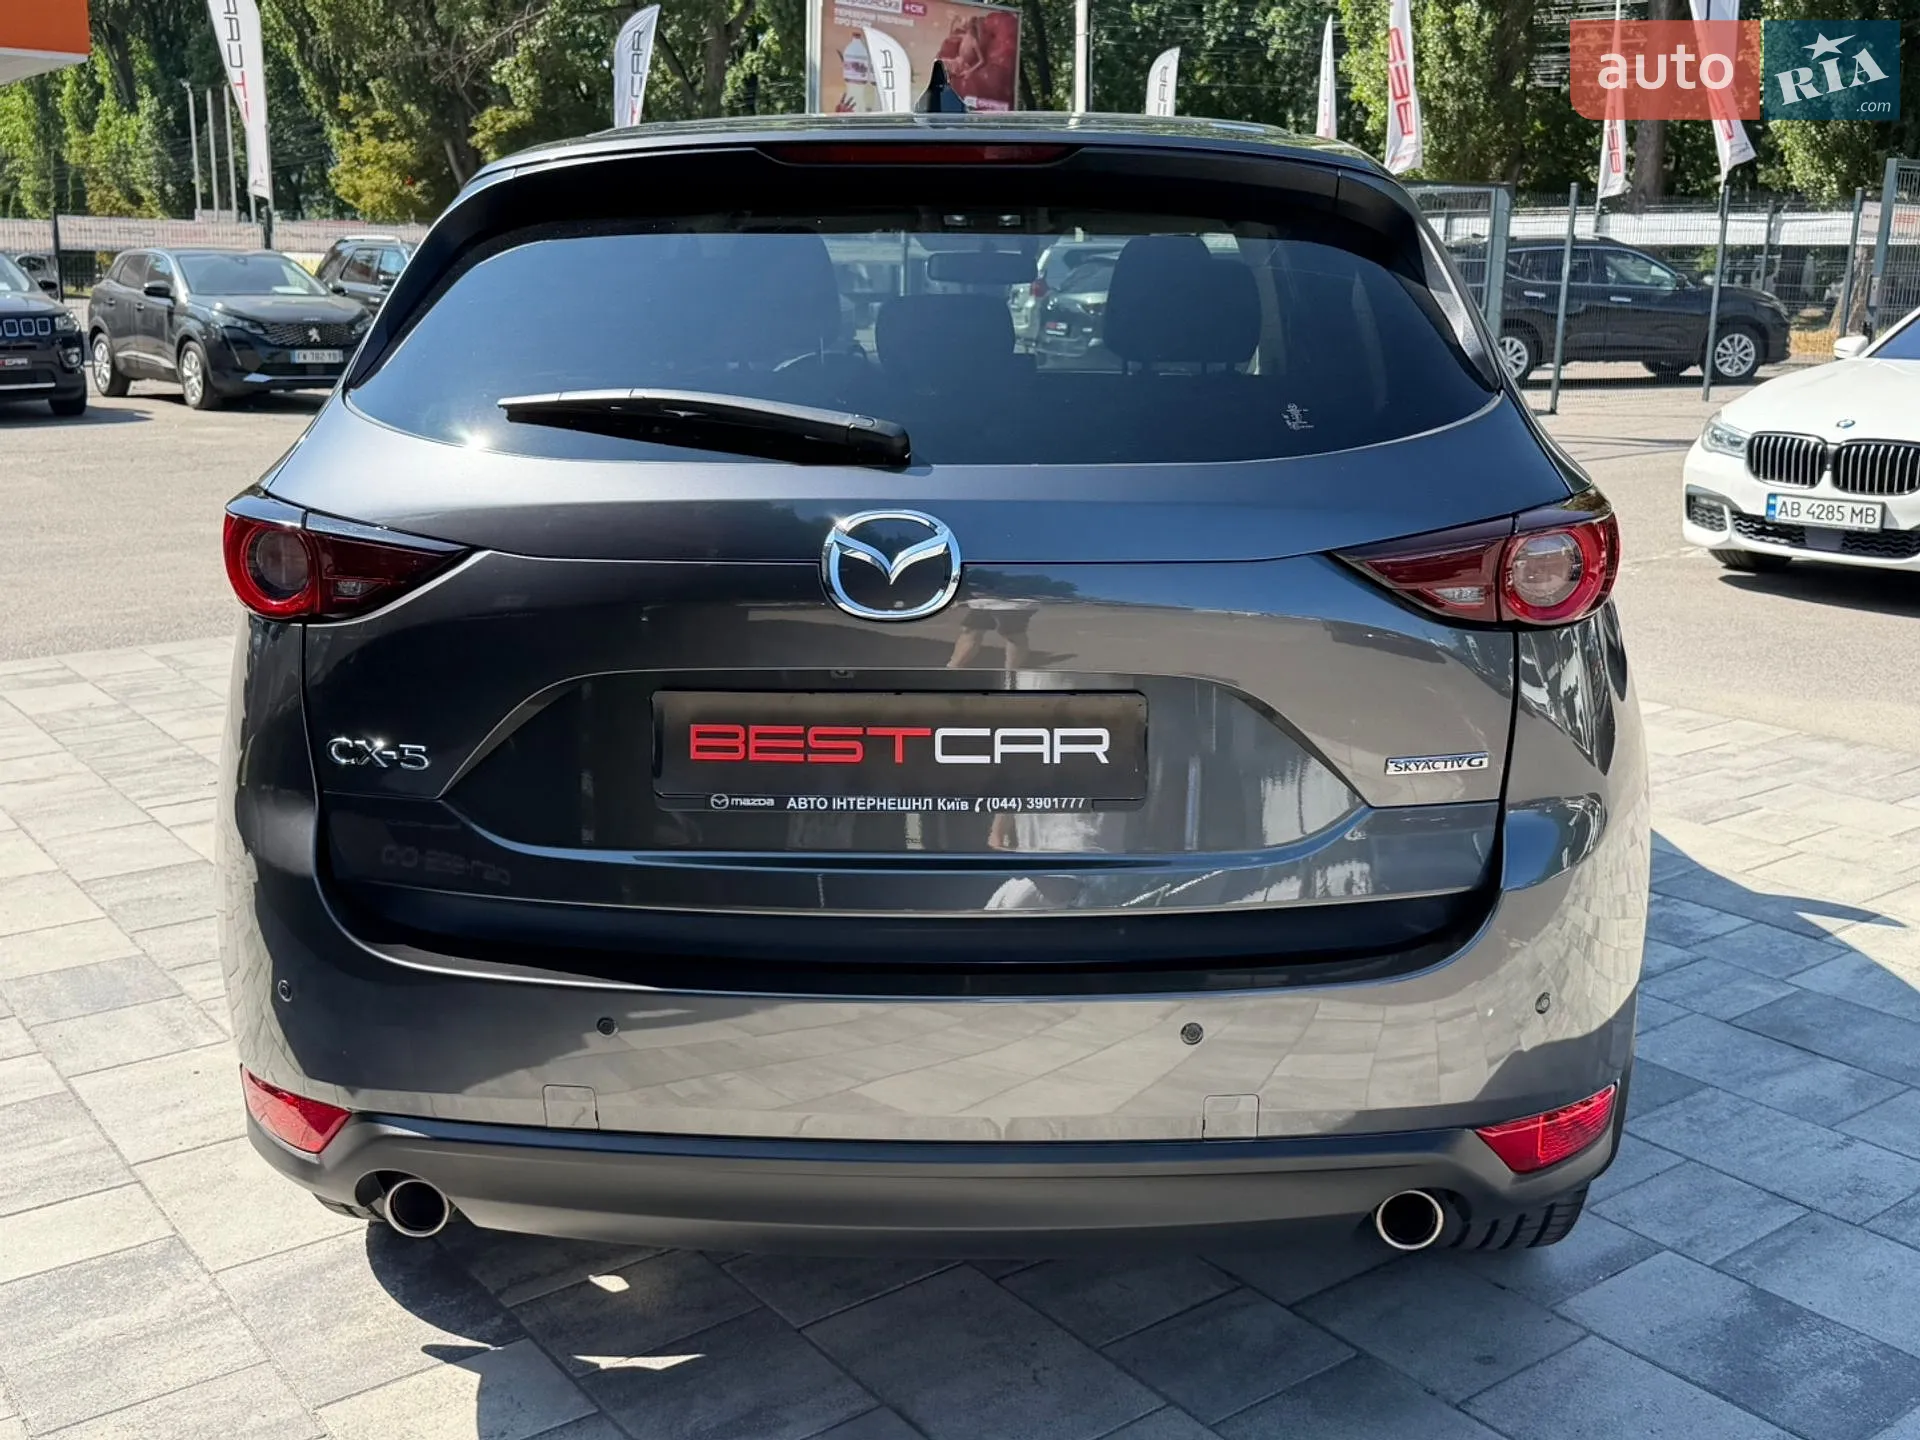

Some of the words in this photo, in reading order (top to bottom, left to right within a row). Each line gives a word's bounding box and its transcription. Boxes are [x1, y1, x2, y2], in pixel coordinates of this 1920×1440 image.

[1778, 501, 1801, 518] AB
[1806, 503, 1845, 522] 4285
[1850, 507, 1876, 524] MB
[326, 736, 432, 771] CX-5
[689, 724, 1111, 765] BESTCAR
[786, 797, 828, 810] АВТО
[832, 797, 932, 811] ІНТЕРНЕШНЛ
[937, 797, 969, 811] Київ
[986, 797, 1023, 812] (044)
[1026, 797, 1086, 809] 3901777
